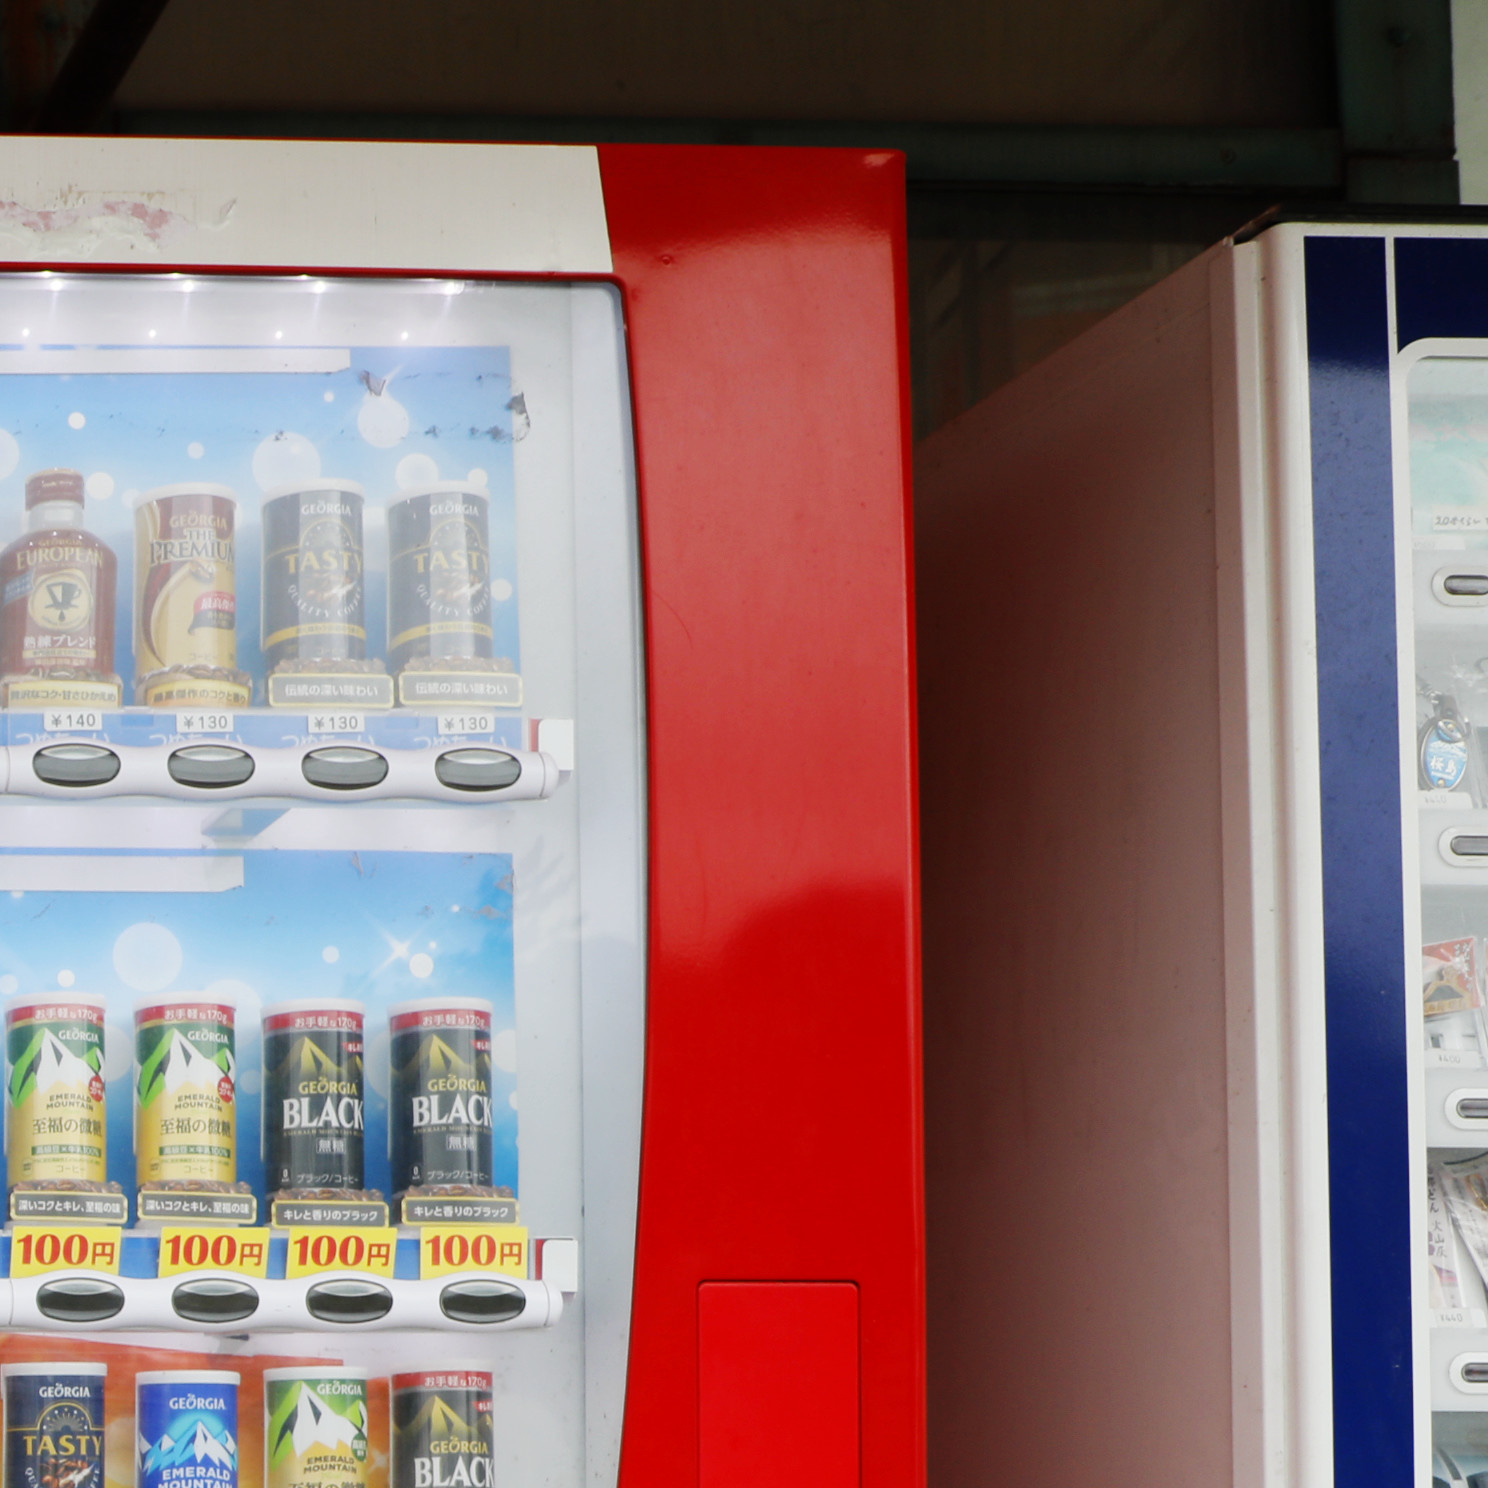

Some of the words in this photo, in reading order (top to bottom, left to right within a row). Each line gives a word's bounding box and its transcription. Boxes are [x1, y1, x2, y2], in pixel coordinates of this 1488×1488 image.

[51, 713, 96, 727] ¥140
[282, 1096, 364, 1131] BLACK
[412, 1093, 494, 1129] BLACK
[283, 1209, 379, 1222] キレと香りのブラック
[413, 1206, 509, 1218] キレと香りのブラック
[16, 1233, 115, 1266] 100円
[165, 1234, 263, 1266] 100円
[293, 1235, 391, 1267] 100円
[425, 1234, 523, 1266] 100円
[23, 1435, 103, 1459] TASTY
[162, 1467, 231, 1482] EMERALD
